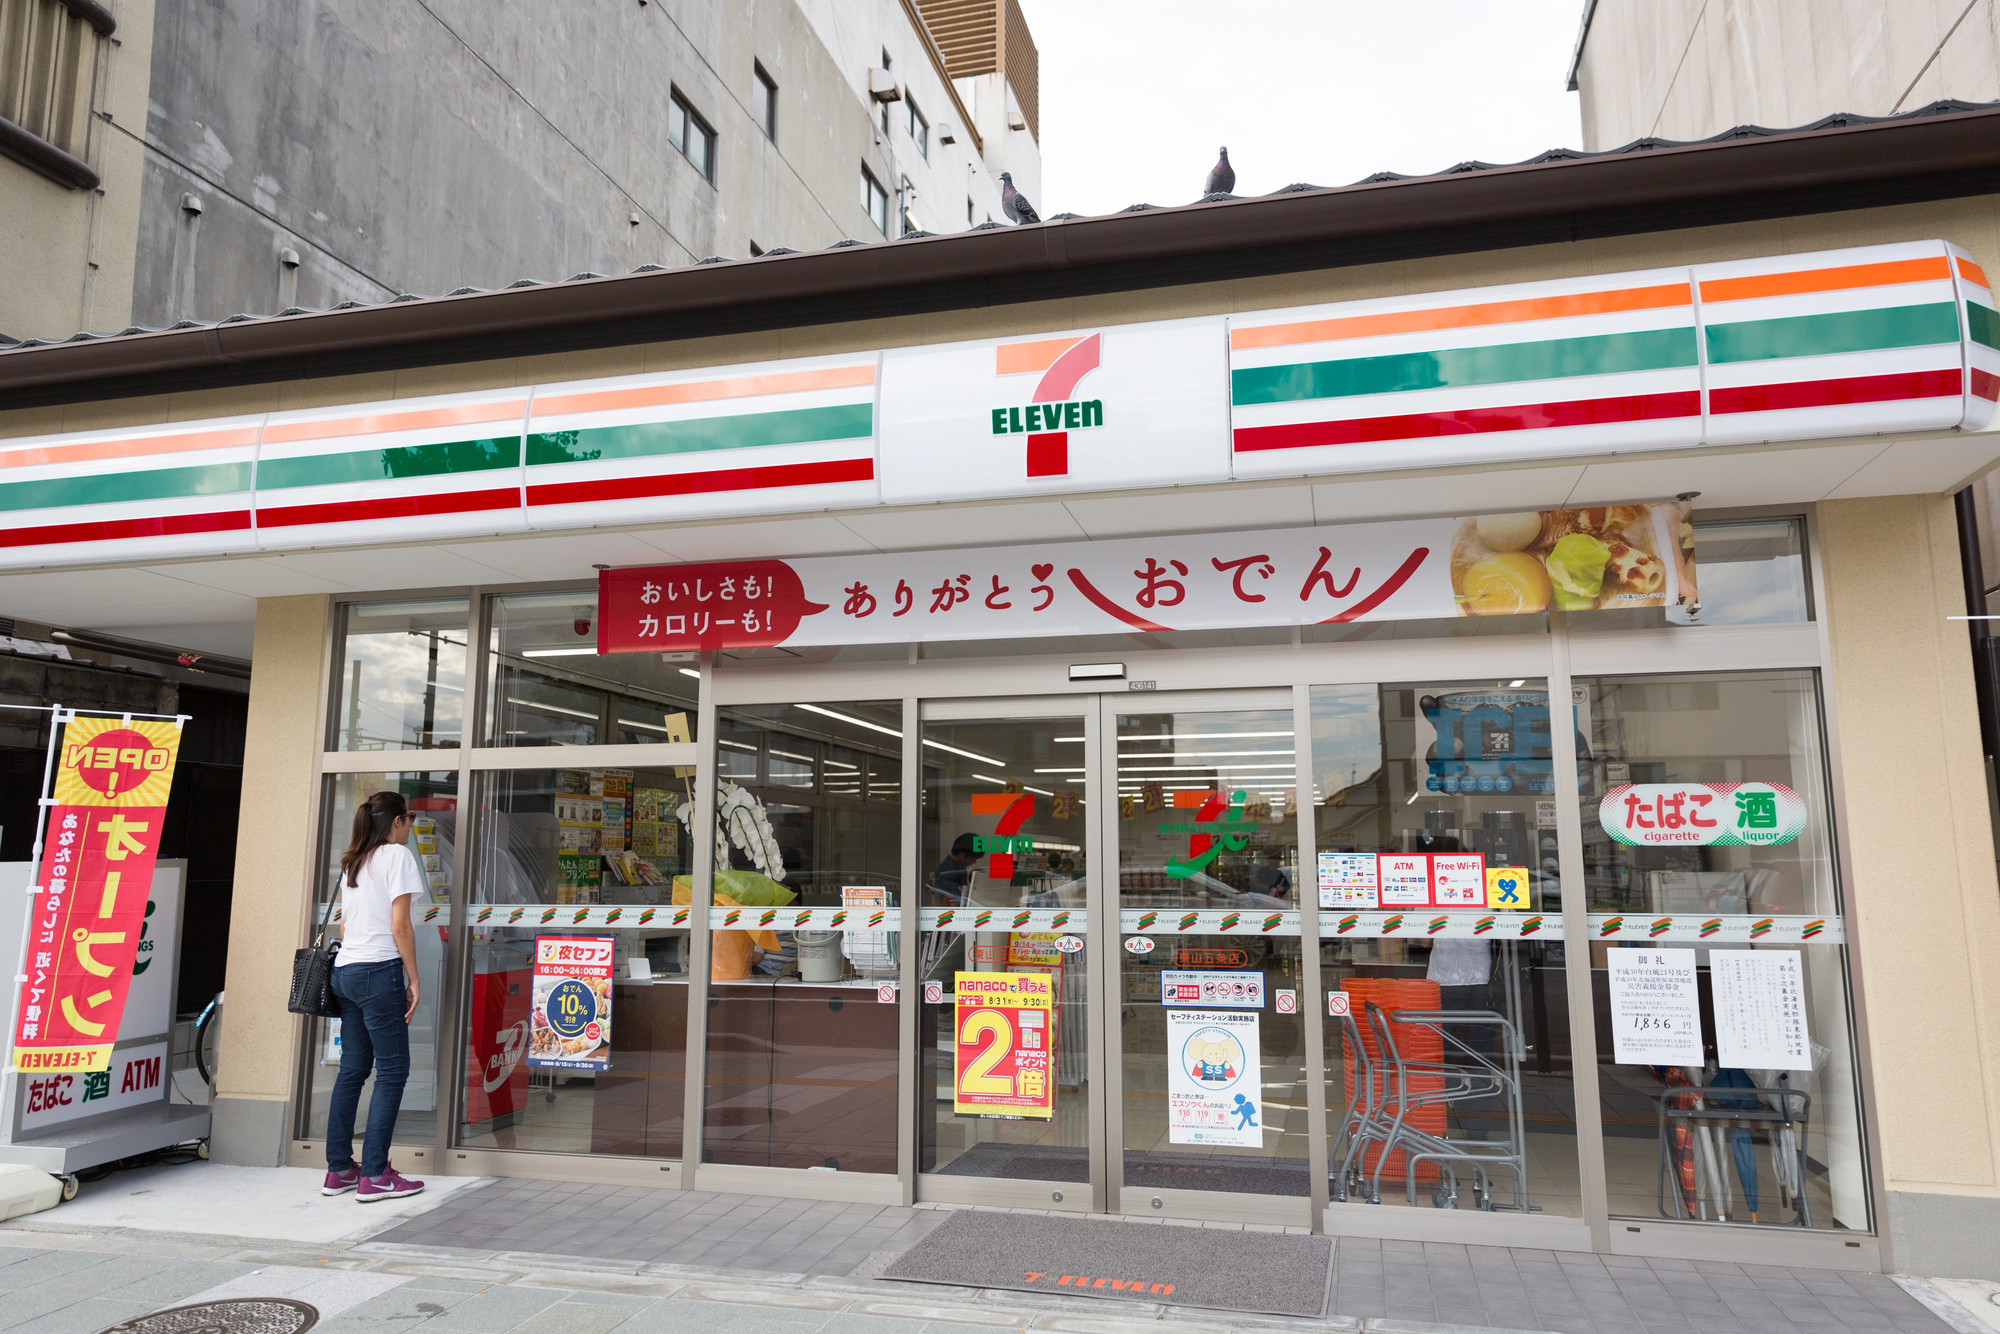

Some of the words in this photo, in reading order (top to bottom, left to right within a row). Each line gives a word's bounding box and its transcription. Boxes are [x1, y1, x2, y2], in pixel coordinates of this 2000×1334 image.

[1134, 546, 1361, 609] おでん
[843, 564, 1054, 618] ありがとう
[1131, 681, 1155, 690] 436141
[1624, 791, 1718, 829] たばこ
[1735, 791, 1777, 828] 酒
[1203, 822, 1257, 833] HOLDINGS
[1644, 831, 1700, 842] cigarette
[1743, 831, 1780, 842] liquor
[1394, 862, 1414, 870] ATM
[1436, 862, 1455, 870] Free
[1458, 862, 1480, 870] Wi-Fi
[559, 945, 611, 962] 夜セブン
[974, 948, 1030, 961] 東山五条店
[1178, 952, 1240, 964] 東山五条店
[1615, 968, 1691, 977] 平成30年台風21号及び
[562, 985, 582, 993] おでん
[557, 994, 588, 1016] 10%
[565, 1016, 576, 1024] 引き
[1170, 1013, 1255, 1022] セーフティステーション活動実施店
[958, 1008, 1014, 1096] 2
[1015, 1049, 1046, 1058] nanaco
[490, 1049, 519, 1069] BANK
[1015, 1058, 1047, 1067] ポイント
[1205, 1065, 1222, 1075] SS
[27, 1077, 73, 1114] たばこ
[82, 1066, 110, 1103] 酒
[121, 1056, 161, 1093] ATM
[1016, 1067, 1046, 1098] 倍
[1197, 1109, 1208, 1117] 119
